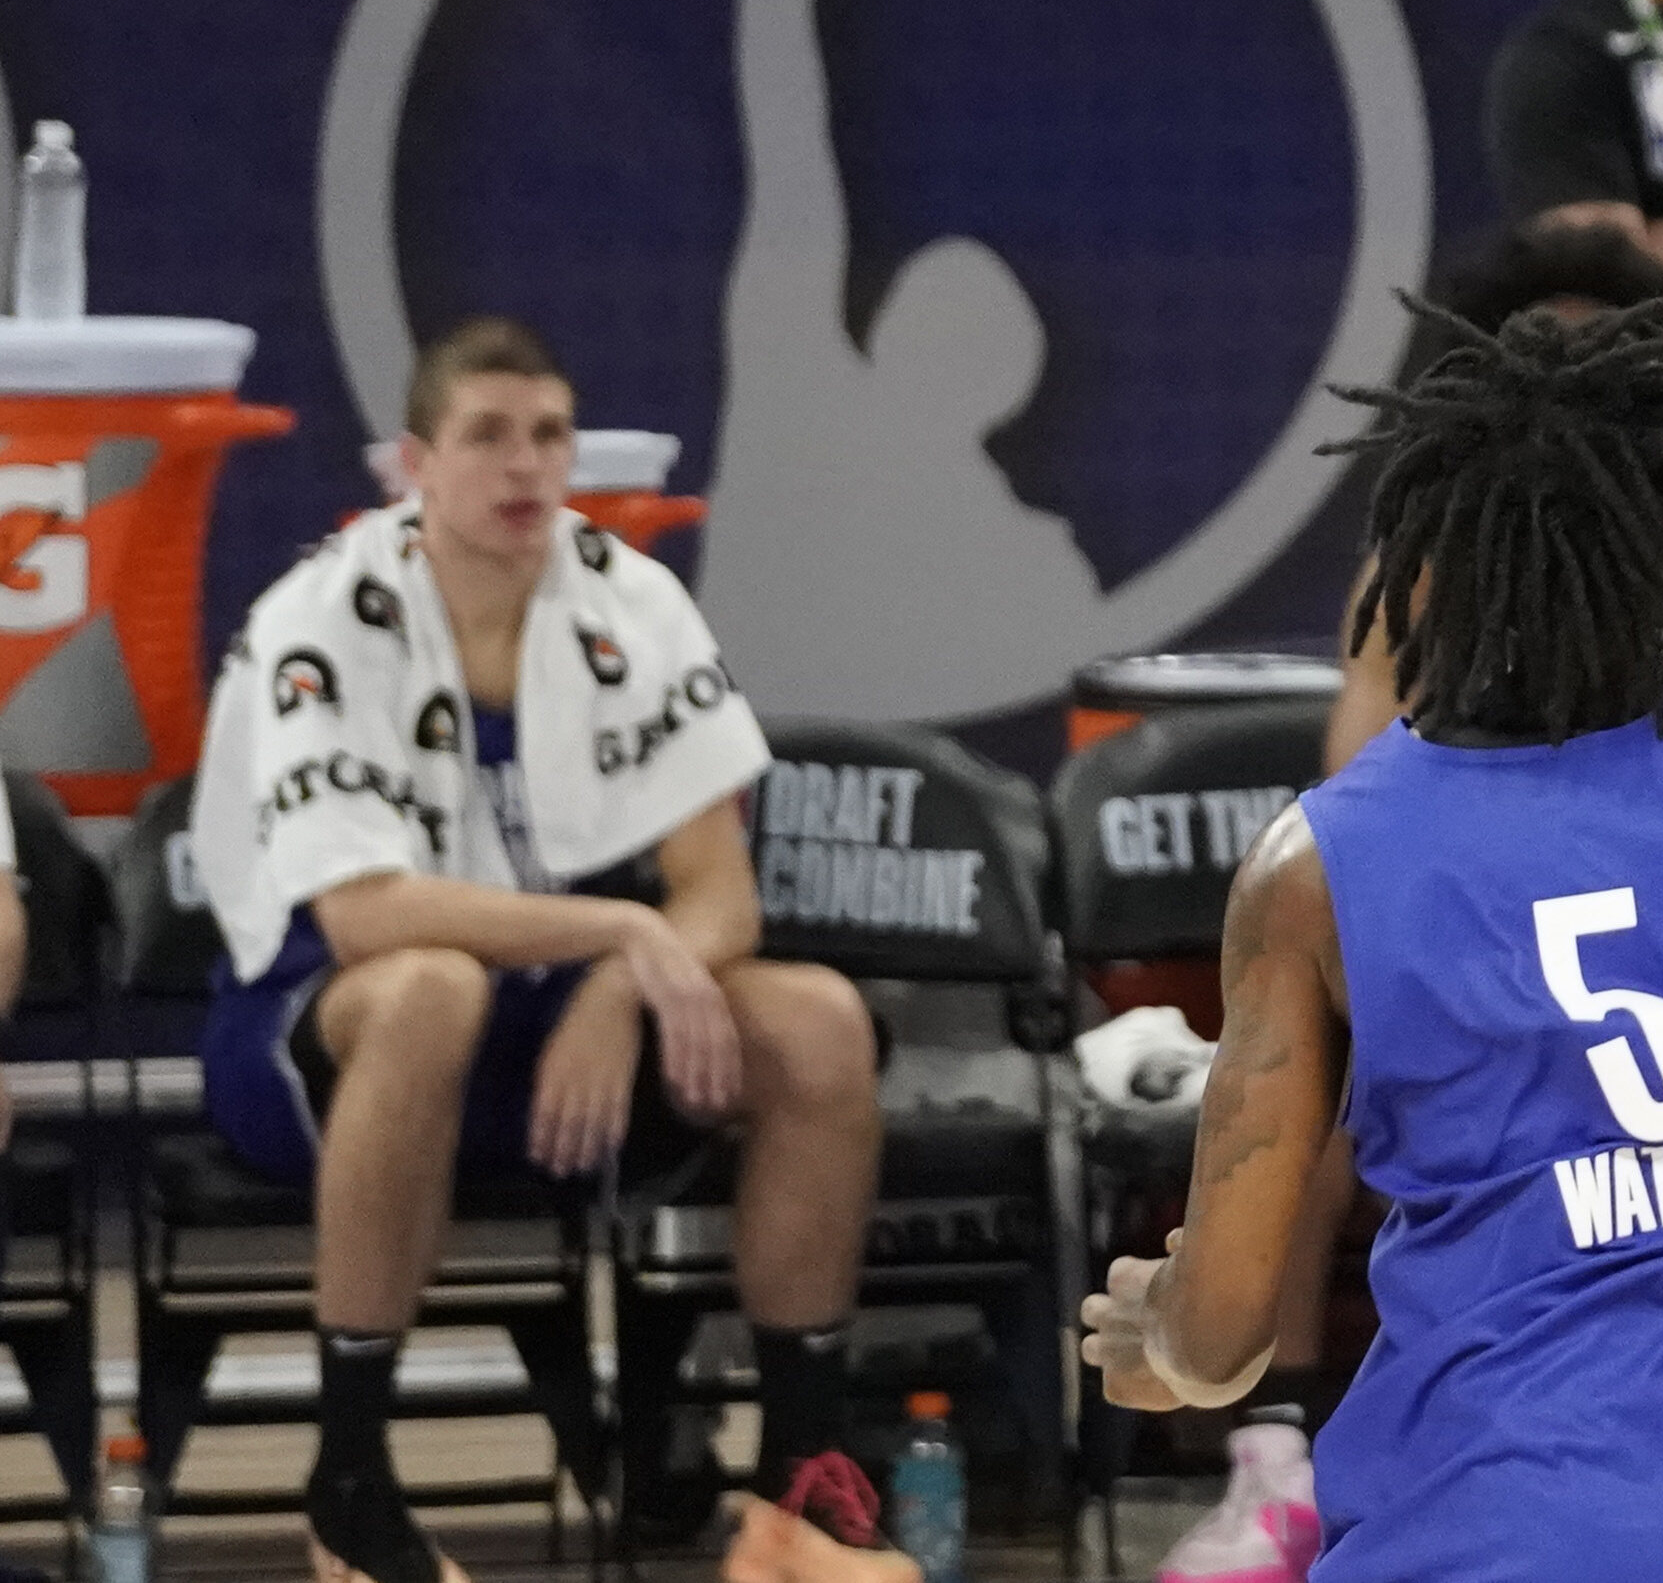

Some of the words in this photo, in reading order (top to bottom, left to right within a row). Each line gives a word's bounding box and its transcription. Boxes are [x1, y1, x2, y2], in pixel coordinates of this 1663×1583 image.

[766, 760, 925, 847] DRAFT
[1100, 796, 1194, 873] GET
[761, 837, 985, 935] COMBINE
